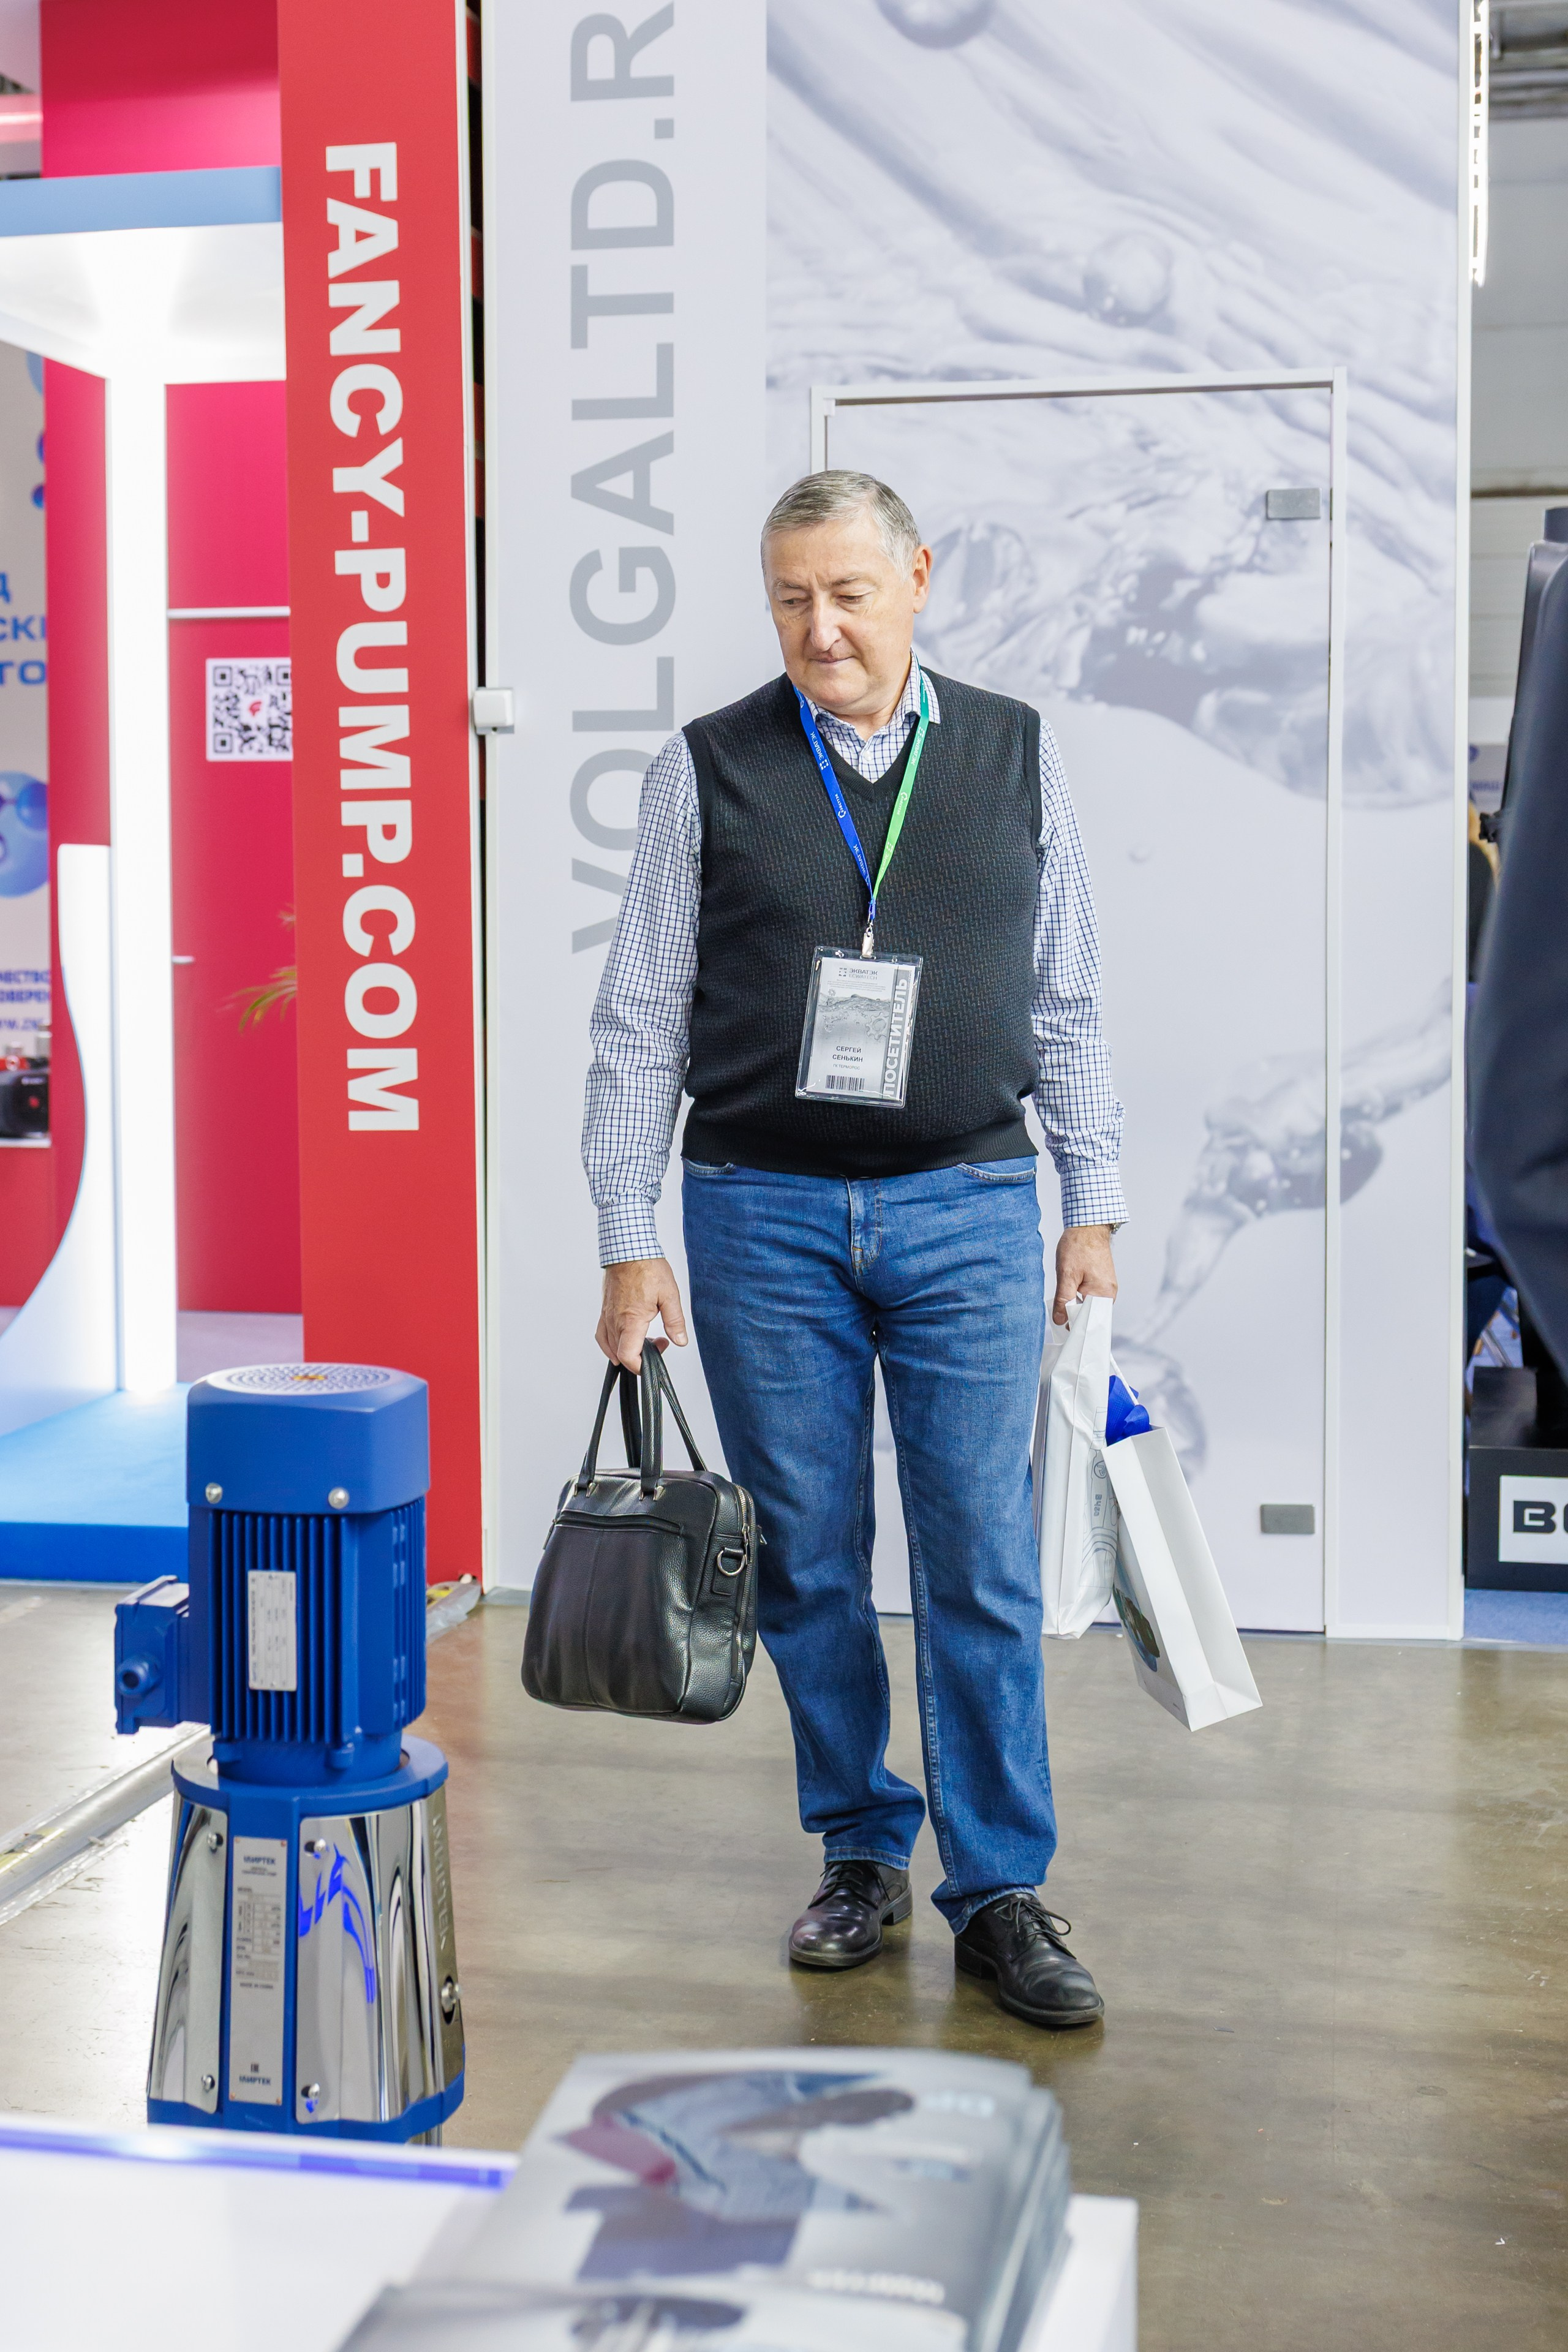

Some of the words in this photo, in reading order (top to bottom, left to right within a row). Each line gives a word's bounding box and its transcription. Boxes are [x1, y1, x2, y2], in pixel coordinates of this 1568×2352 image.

[325, 141, 420, 1132] FANCY-PUMP.COM
[810, 731, 824, 761] ЭКВАТЭК
[911, 737, 922, 766] ЭКВАТЭК
[883, 979, 908, 1096] ПОСЕТИТЕЛЬ
